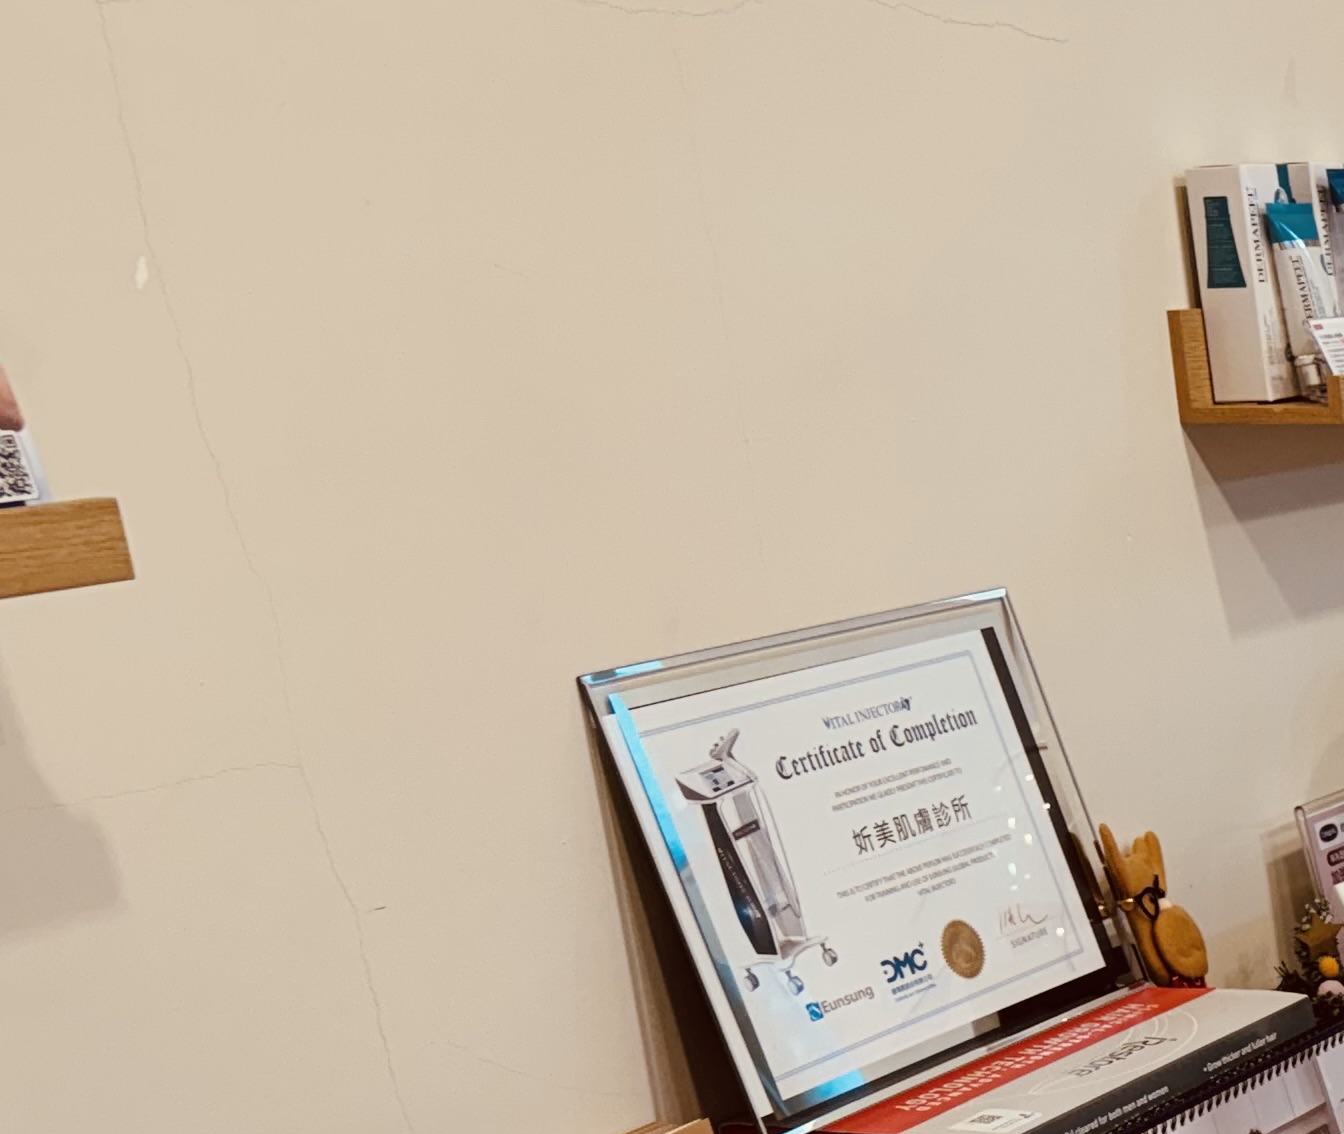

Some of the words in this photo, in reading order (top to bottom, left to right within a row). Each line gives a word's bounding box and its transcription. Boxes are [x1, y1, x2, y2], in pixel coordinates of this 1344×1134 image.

[776, 740, 865, 780] Certificate
[869, 729, 886, 754] of
[889, 708, 978, 747] Completion
[821, 986, 875, 1014] Eunsung
